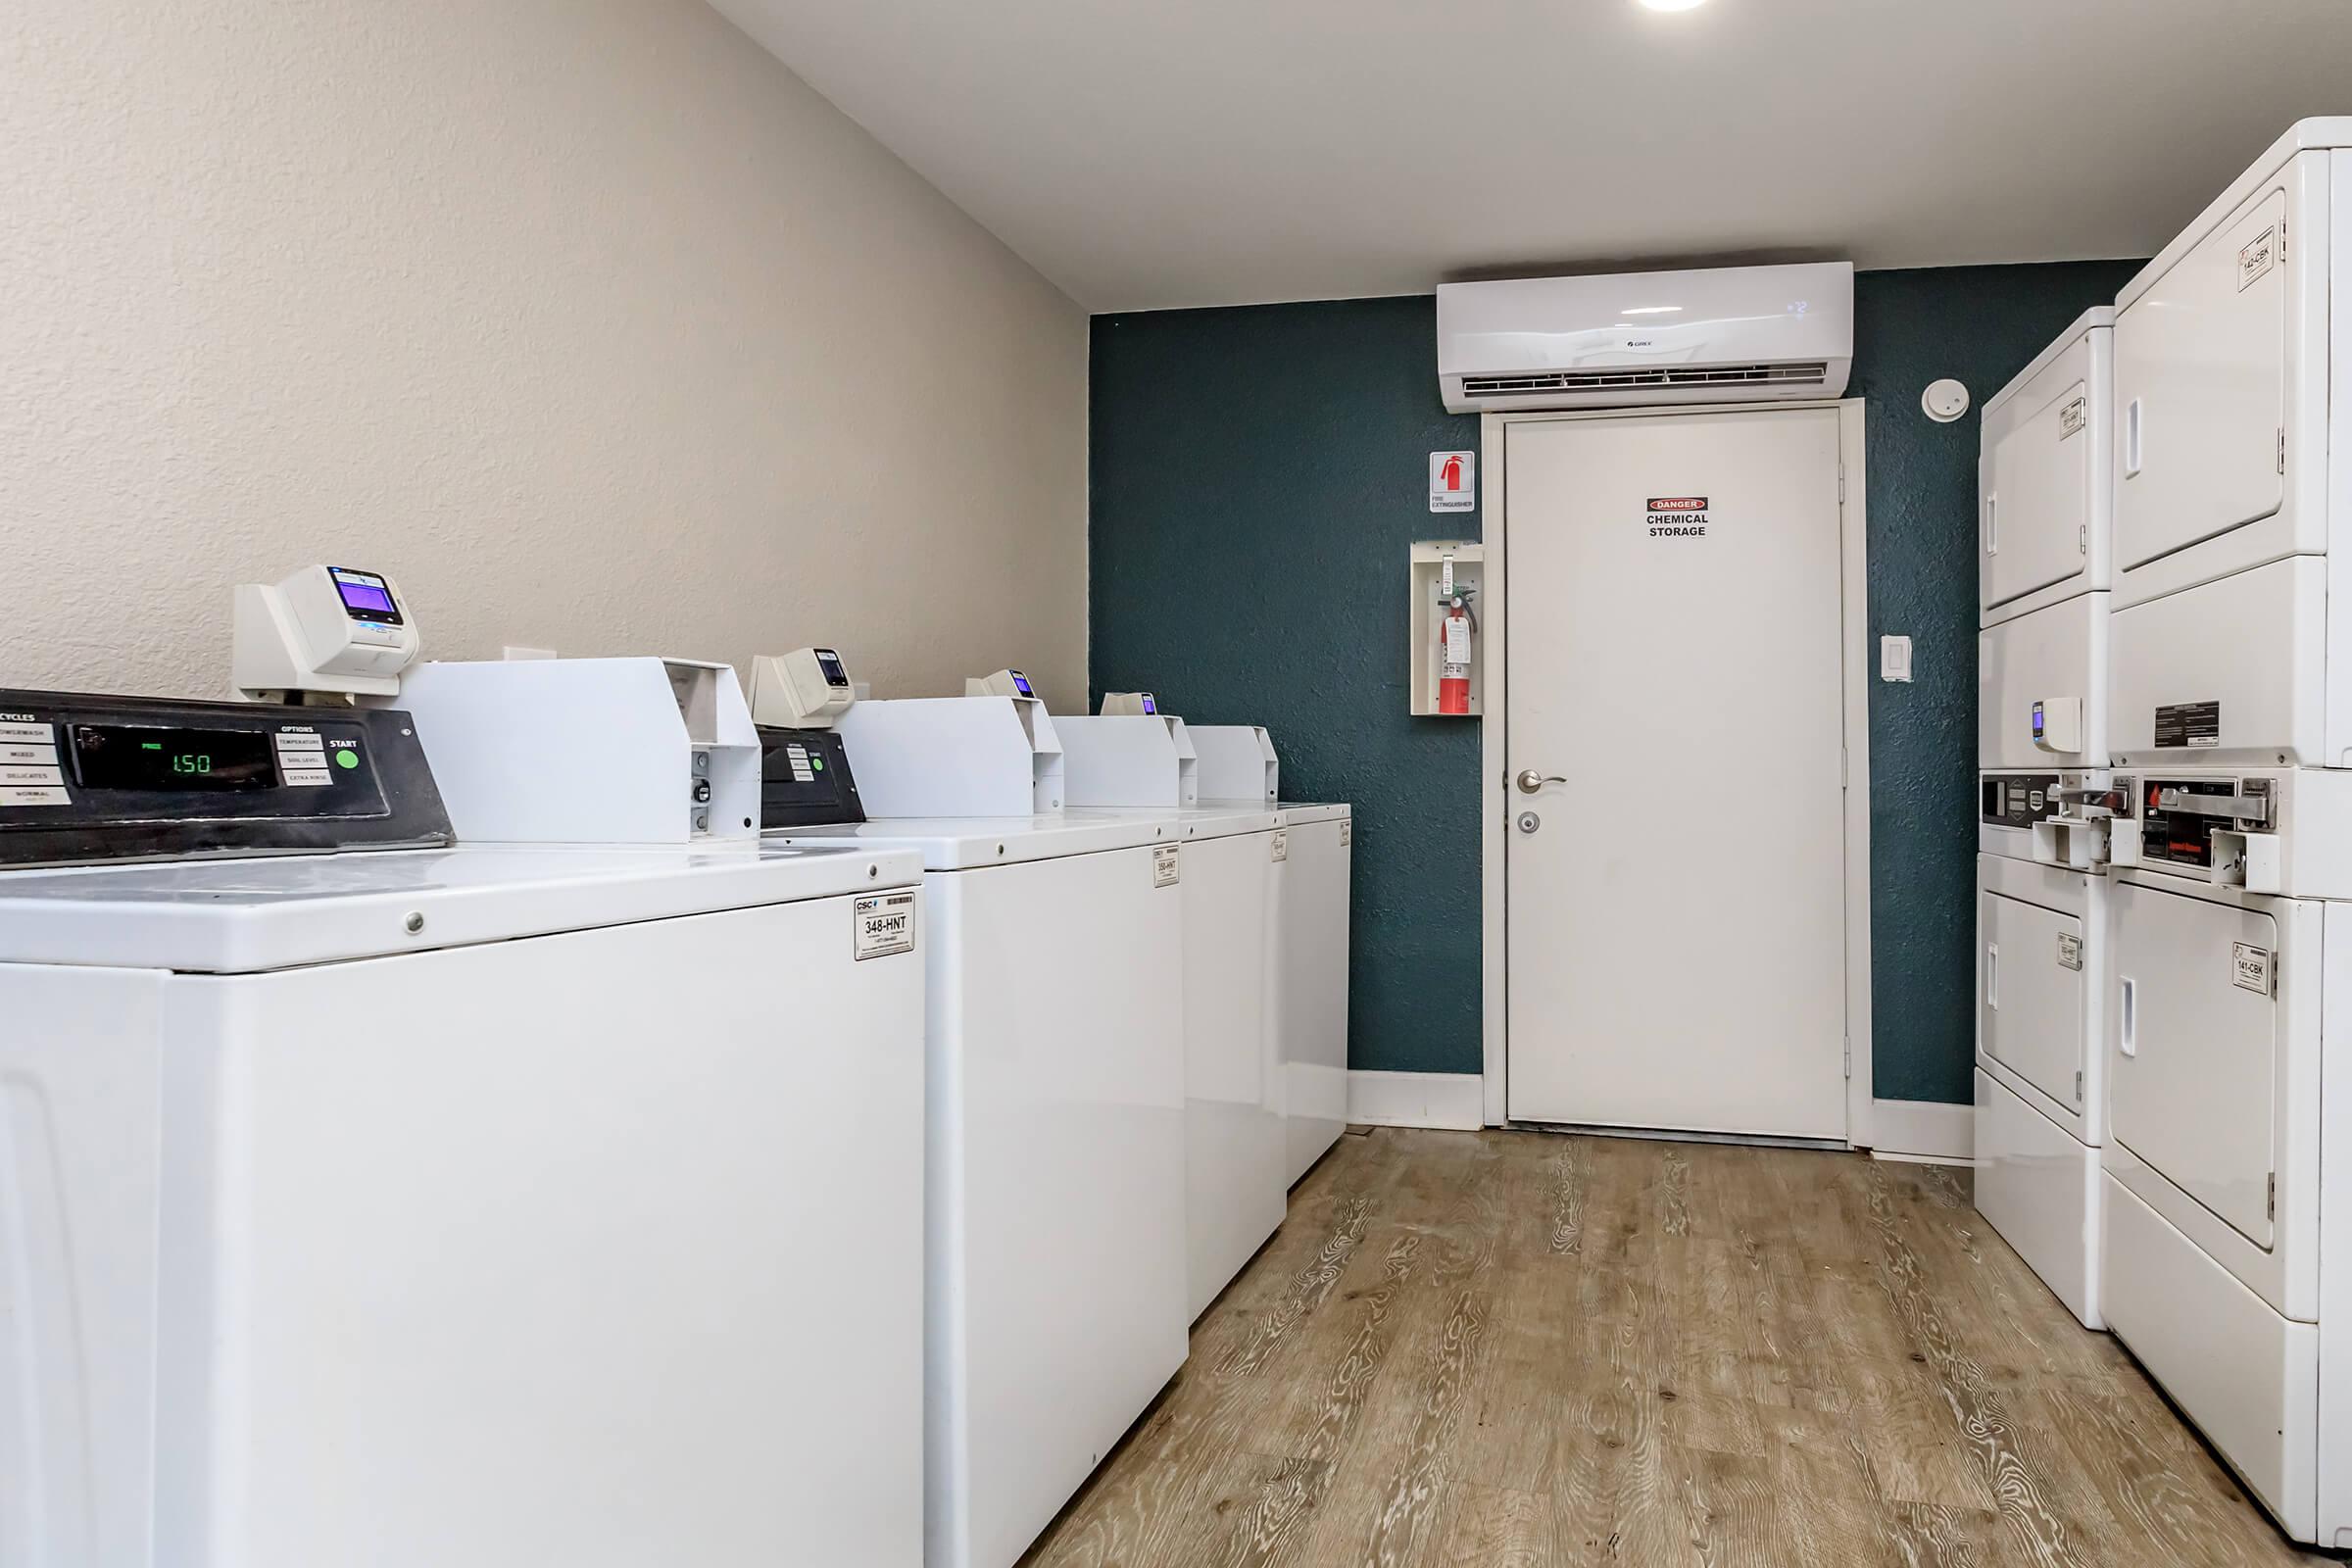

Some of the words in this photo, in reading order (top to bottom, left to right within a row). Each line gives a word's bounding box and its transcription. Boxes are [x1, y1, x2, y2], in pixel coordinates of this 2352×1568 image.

[1646, 514, 1708, 524] CHEMICAL
[1649, 526, 1706, 536] STORAGE
[0, 712, 35, 721] CYCLES
[857, 901, 873, 910] CSC
[865, 915, 906, 934] 348-HNT
[2238, 960, 2264, 976] 141-CBK
